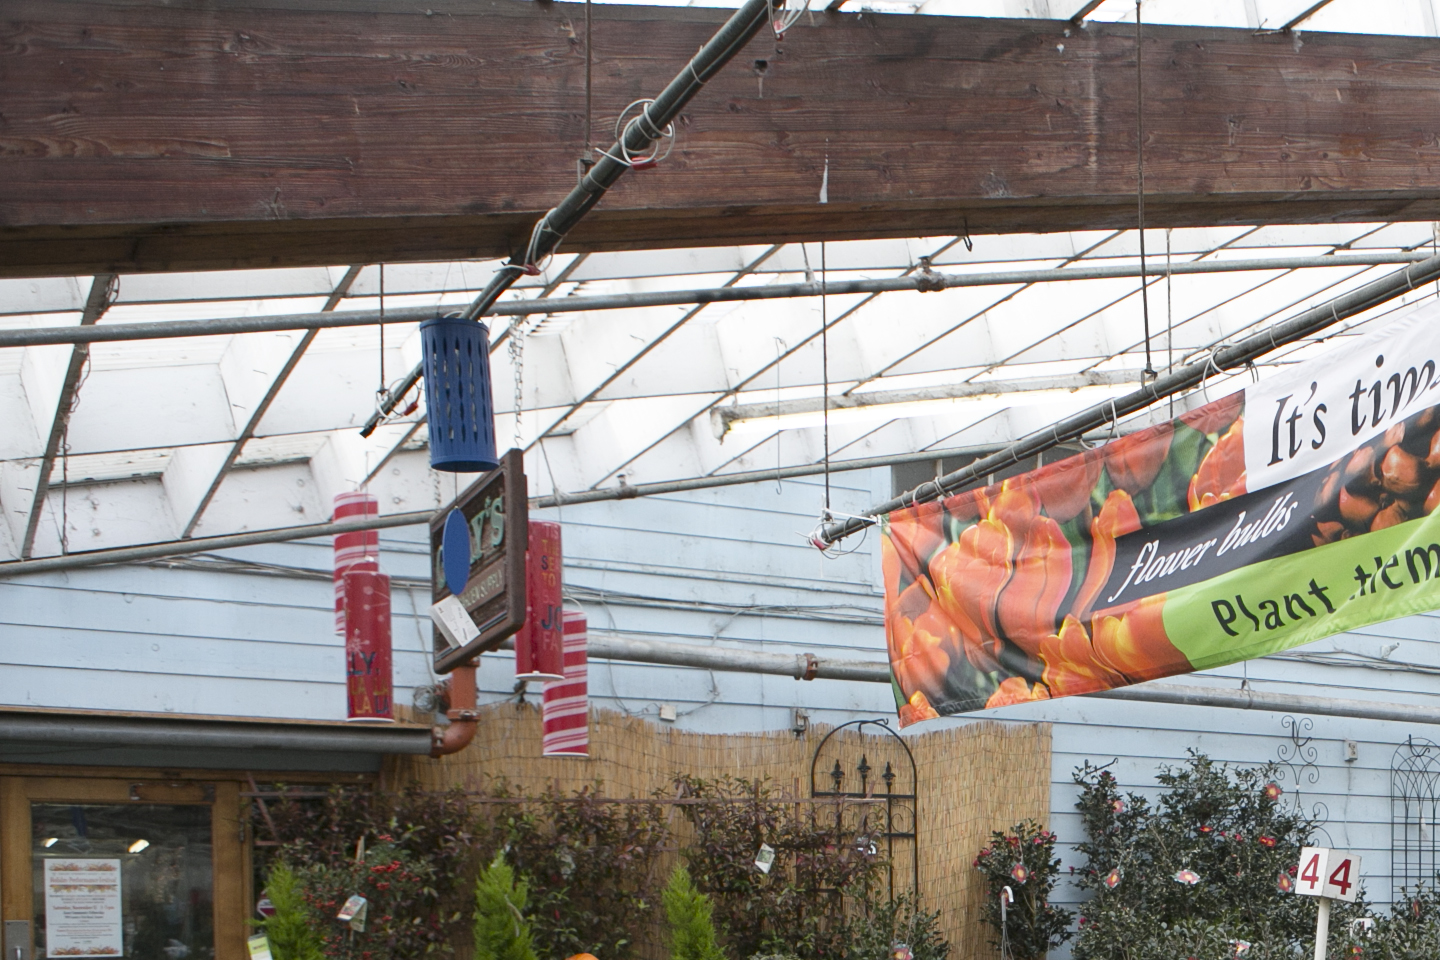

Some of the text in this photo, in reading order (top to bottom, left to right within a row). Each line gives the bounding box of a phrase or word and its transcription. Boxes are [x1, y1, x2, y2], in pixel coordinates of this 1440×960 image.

[1267, 381, 1328, 467] It's
[1108, 492, 1298, 602] flower bulbs
[1210, 578, 1334, 637] Plant
[1301, 853, 1320, 890] 4
[1329, 858, 1352, 895] 4
